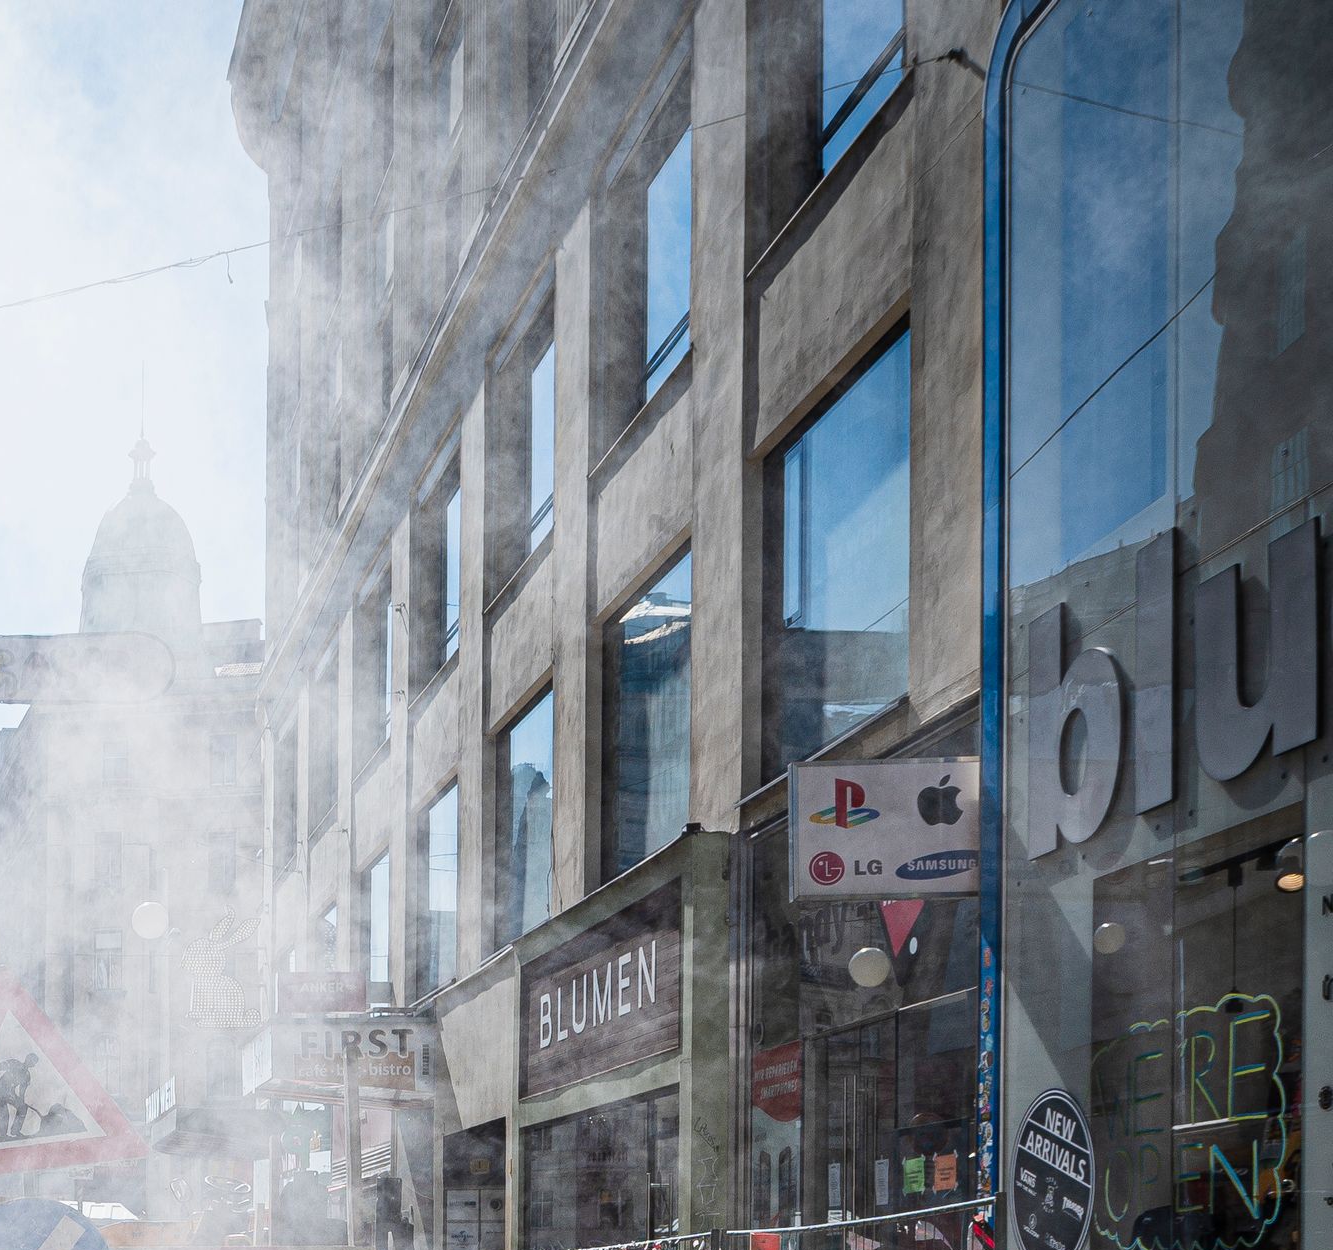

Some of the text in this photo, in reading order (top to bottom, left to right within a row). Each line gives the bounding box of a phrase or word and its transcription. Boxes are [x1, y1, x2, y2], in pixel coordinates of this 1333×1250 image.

[1028, 516, 1321, 863] blu
[854, 860, 882, 876] LG
[299, 981, 344, 993] ANKER
[538, 940, 658, 1051] BLUMEN
[300, 1028, 414, 1060] FIRST
[368, 1062, 412, 1077] bistro
[1044, 1107, 1077, 1142] NEW
[1024, 1130, 1087, 1181] ARRIVALS
